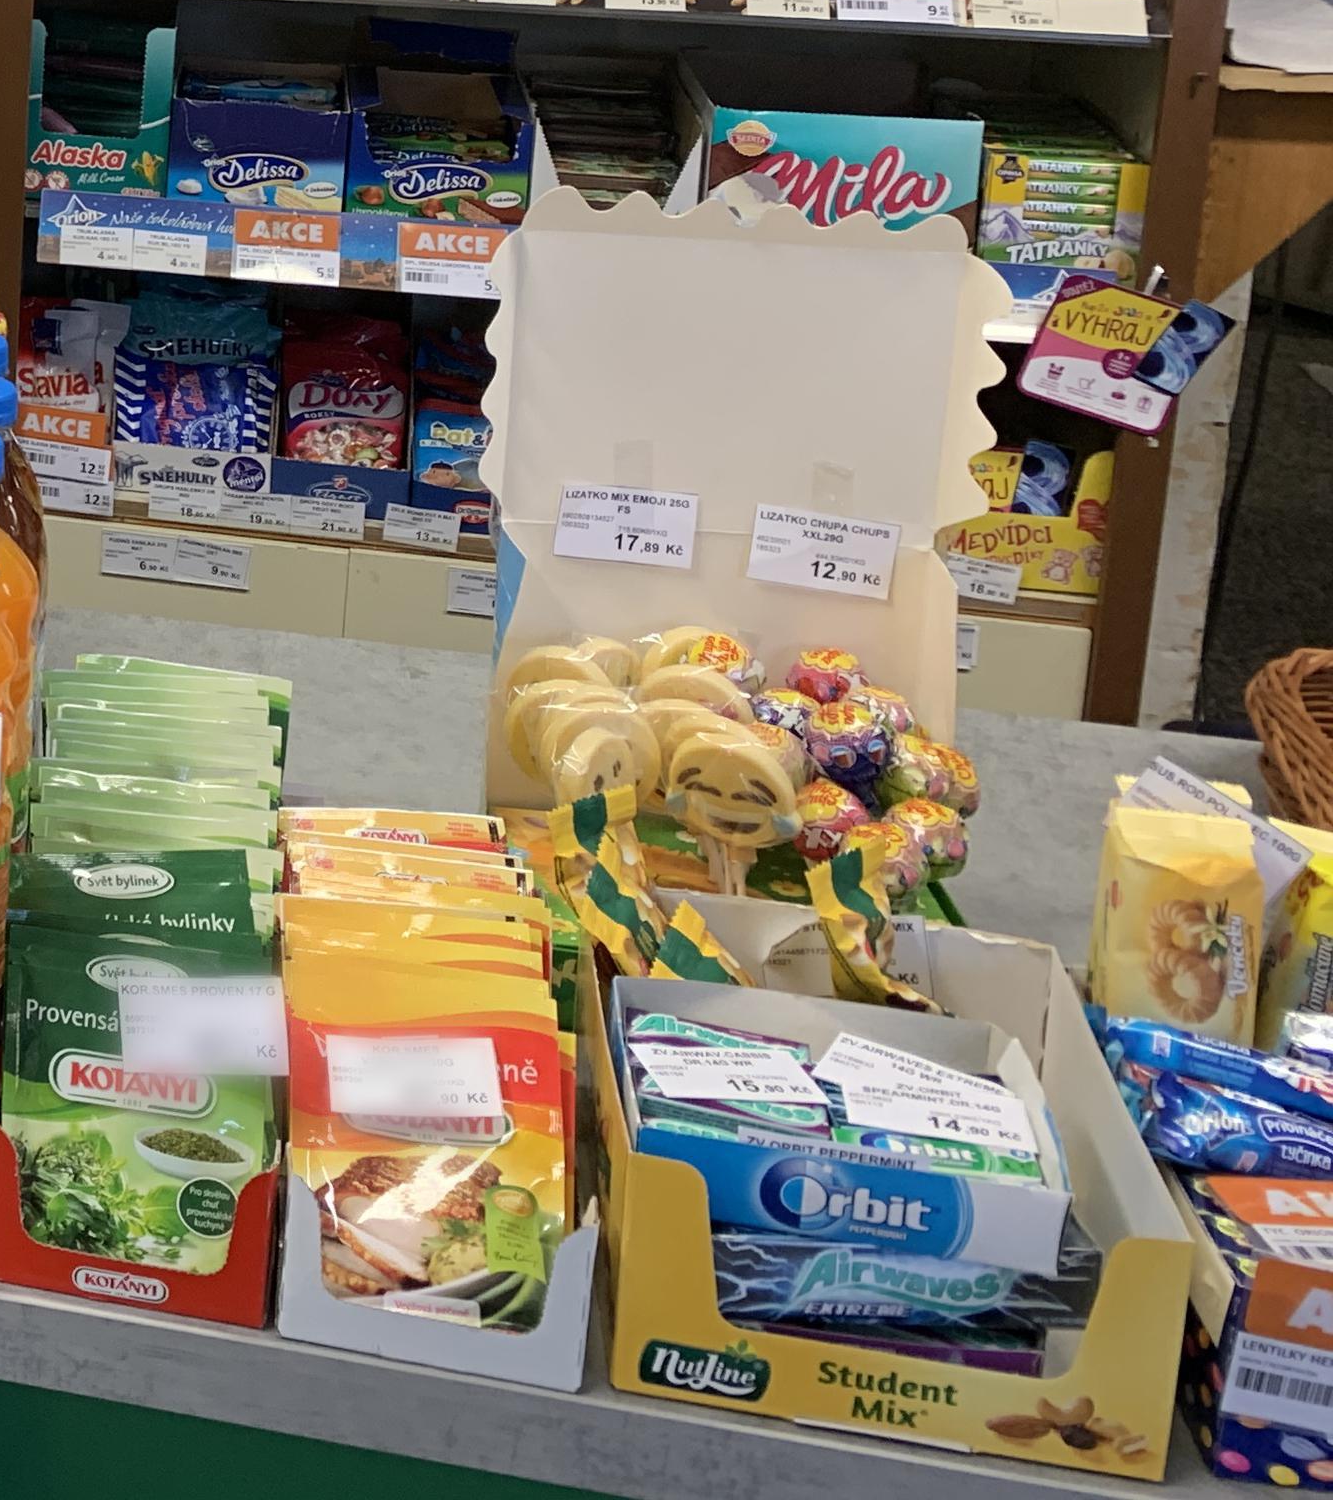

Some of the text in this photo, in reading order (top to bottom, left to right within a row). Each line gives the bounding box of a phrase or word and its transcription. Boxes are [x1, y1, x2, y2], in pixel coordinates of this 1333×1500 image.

[32, 140, 126, 170] Alaska
[399, 171, 480, 195] Delissa
[756, 146, 952, 227] Mila
[251, 219, 323, 241] AKCE
[1007, 241, 1108, 263] TATRANKY
[18, 367, 89, 398] Savia
[292, 385, 392, 414] Doxy
[22, 414, 91, 438] AKCE
[566, 491, 608, 502] LIZATKO
[610, 493, 629, 504] MIX
[632, 495, 666, 506] EMOJI
[618, 504, 631, 514] FS
[760, 510, 891, 539] LIZATKO CHUPA CHUPS
[614, 535, 659, 554] 17,89
[811, 560, 856, 582] 12,90
[87, 873, 159, 890] Svět bylinek
[70, 1061, 197, 1104] KOTÁNYI
[760, 1157, 931, 1235] Orbit
[84, 1271, 159, 1296] KOTÁNYI
[803, 1251, 1000, 1303] Airwaves
[806, 1301, 909, 1318] EXTREME
[819, 1361, 958, 1407] Student
[852, 1398, 920, 1429] Mix
